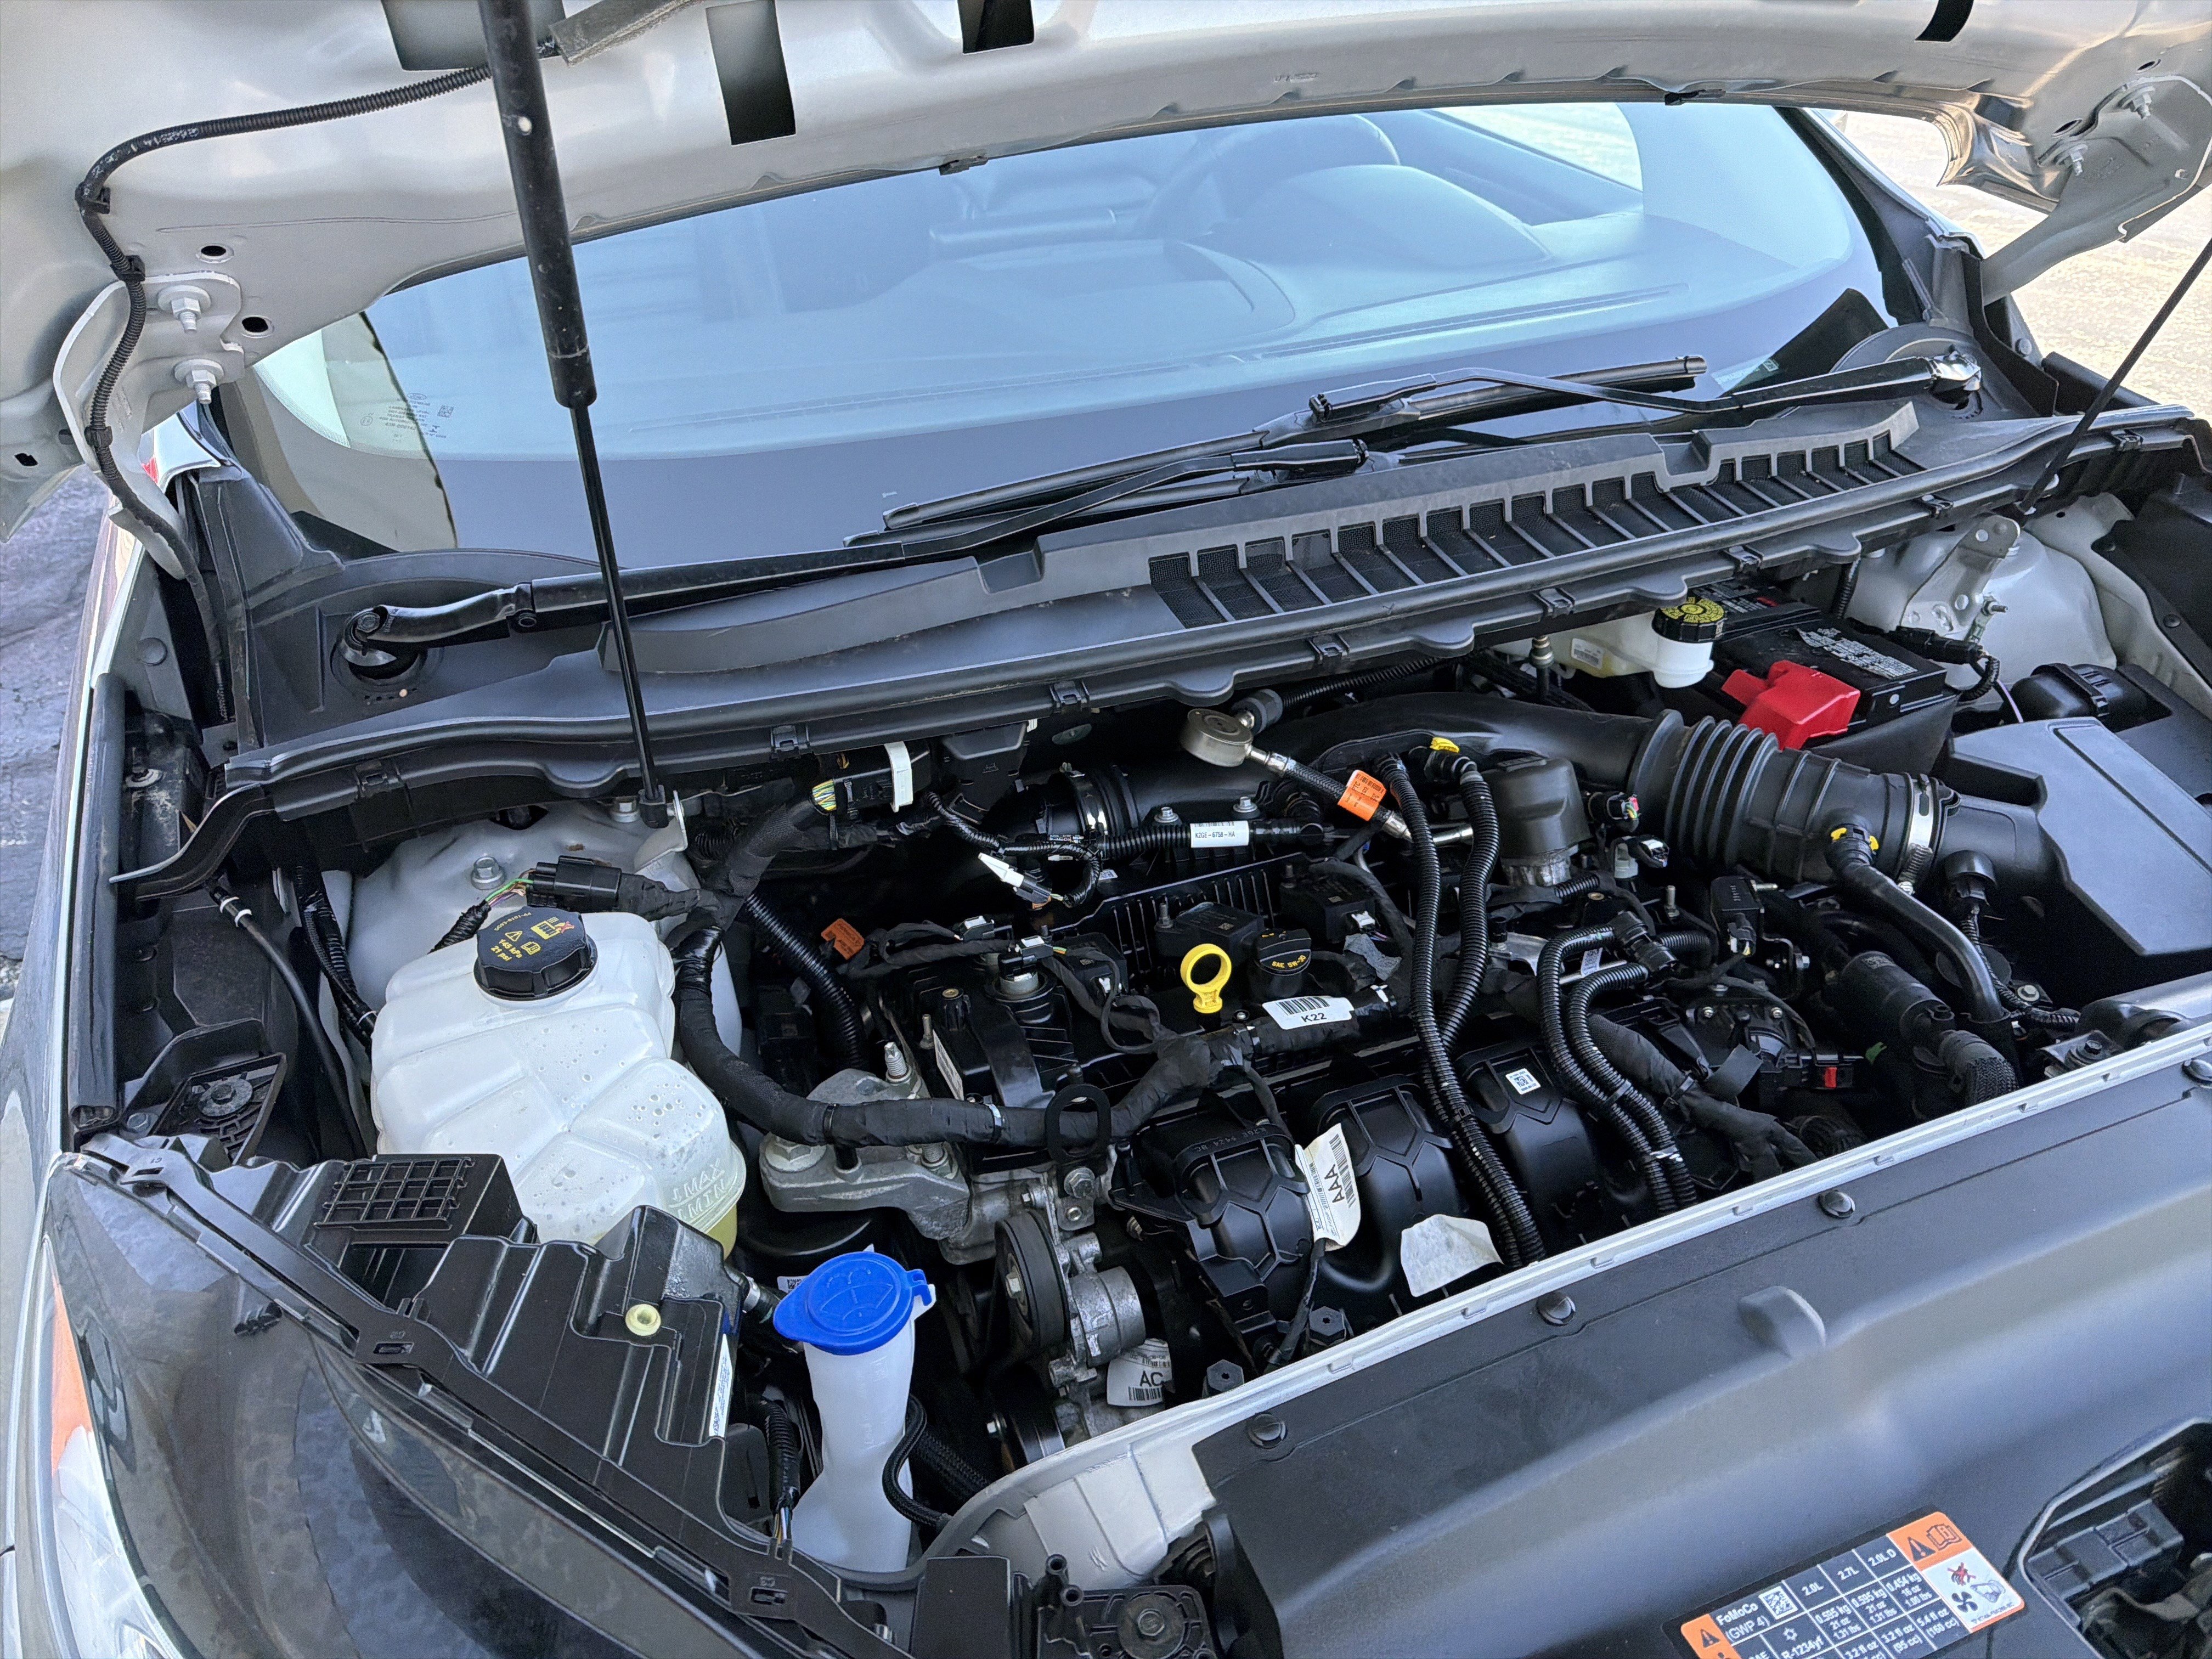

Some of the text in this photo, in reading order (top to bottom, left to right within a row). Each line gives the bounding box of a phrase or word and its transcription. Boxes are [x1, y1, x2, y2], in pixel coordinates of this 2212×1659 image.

[490, 945, 512, 961] 21 psi
[498, 939, 523, 958] 145 kPa
[1286, 955, 1306, 968] 5W-30
[1300, 1012, 1328, 1023] K22
[683, 1158, 725, 1198] MAX
[1324, 1163, 1345, 1204] AAA
[687, 1178, 725, 1218] MIN
[1139, 1370, 1164, 1387] AC
[1867, 1548, 1897, 1567] 2.0L D
[1837, 1566, 1859, 1581] 2.7L
[1906, 1572, 1922, 1583] kg
[1801, 1581, 1824, 1596] 2.0L
[1873, 1587, 1888, 1599] kg
[1911, 1584, 1922, 1593] oz
[1920, 1590, 1933, 1601] lbs
[1837, 1602, 1853, 1615] kg
[1865, 1600, 1887, 1614] 21 oz
[1884, 1607, 1898, 1618] lbs
[1937, 1608, 1950, 1617] oz
[1716, 1603, 1758, 1626] FoMoCo
[1725, 1615, 1770, 1643] (GWP 4)
[1829, 1616, 1852, 1631] 21 oz
[1848, 1623, 1861, 1634] lbs
[1903, 1623, 1915, 1633] oz
[1944, 1617, 1960, 1629] cc)
[1781, 1635, 1824, 1659] R-1234yf
[1866, 1640, 1879, 1650] oz
[1892, 1633, 1923, 1654] (95 cc)
